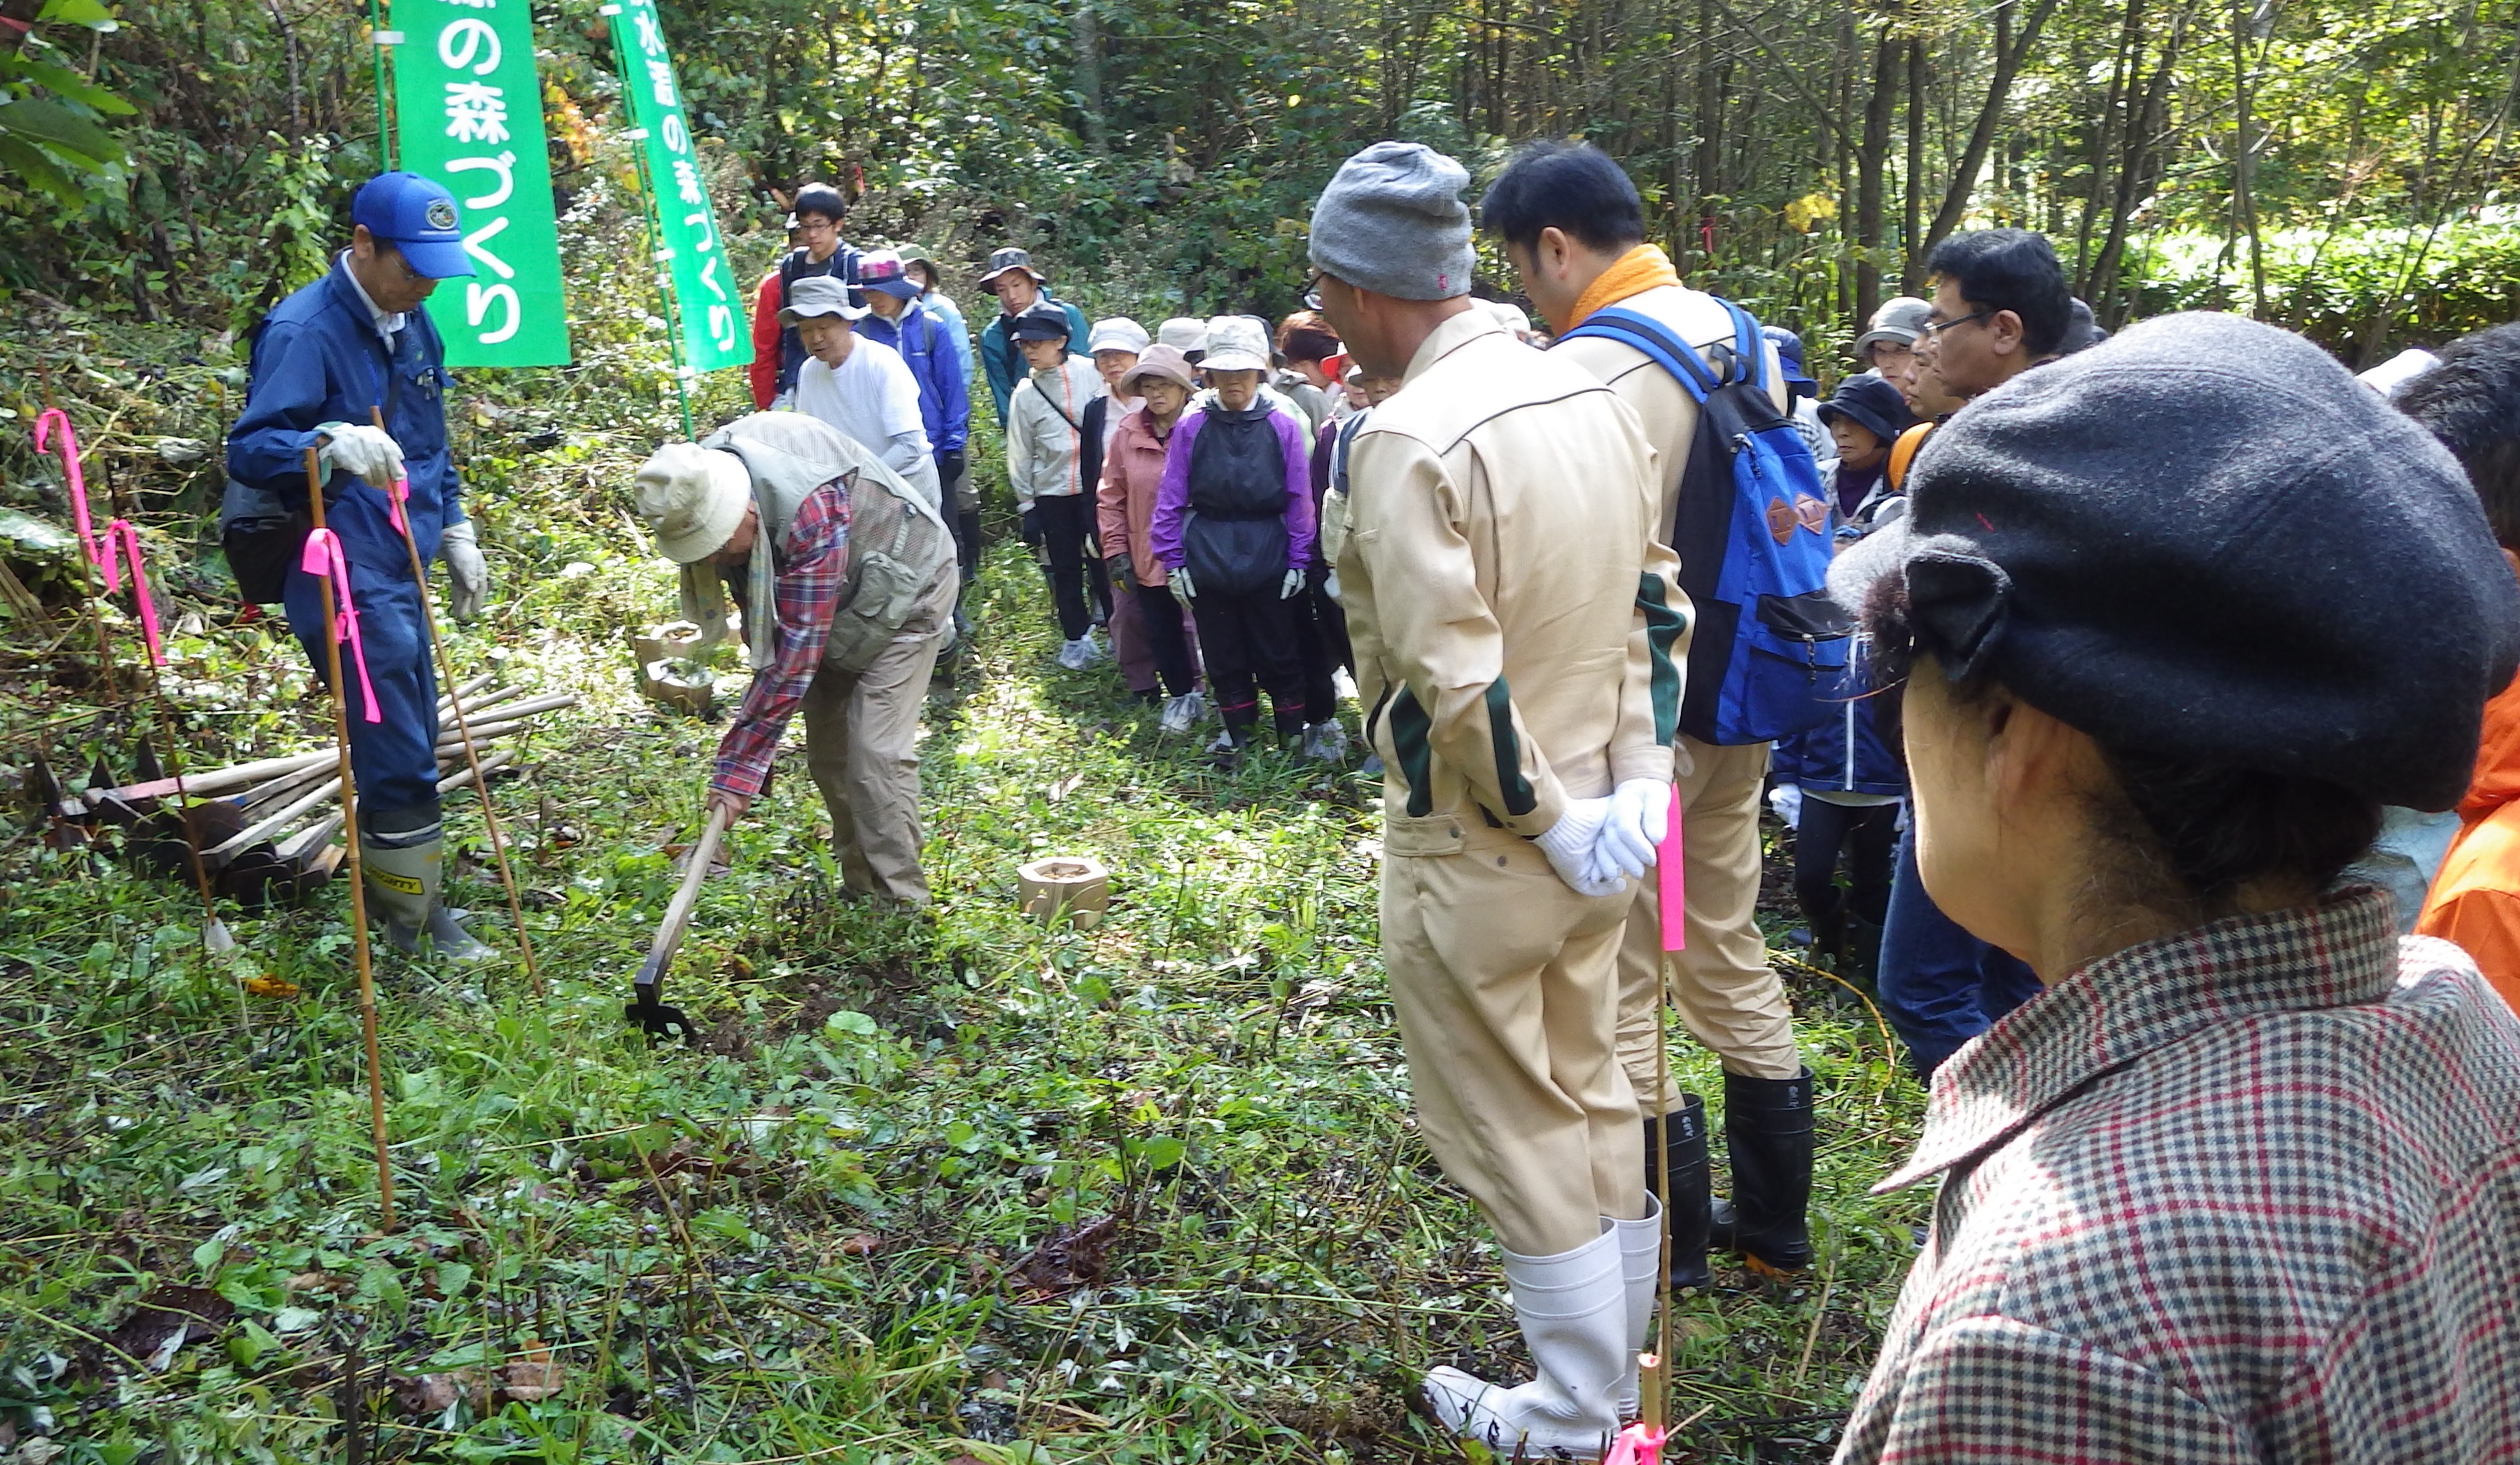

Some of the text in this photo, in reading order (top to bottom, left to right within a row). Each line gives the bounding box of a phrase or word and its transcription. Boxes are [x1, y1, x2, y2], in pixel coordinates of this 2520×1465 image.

[438, 0, 521, 344] の森づくり
[630, 0, 735, 351] 水道の森づくり
